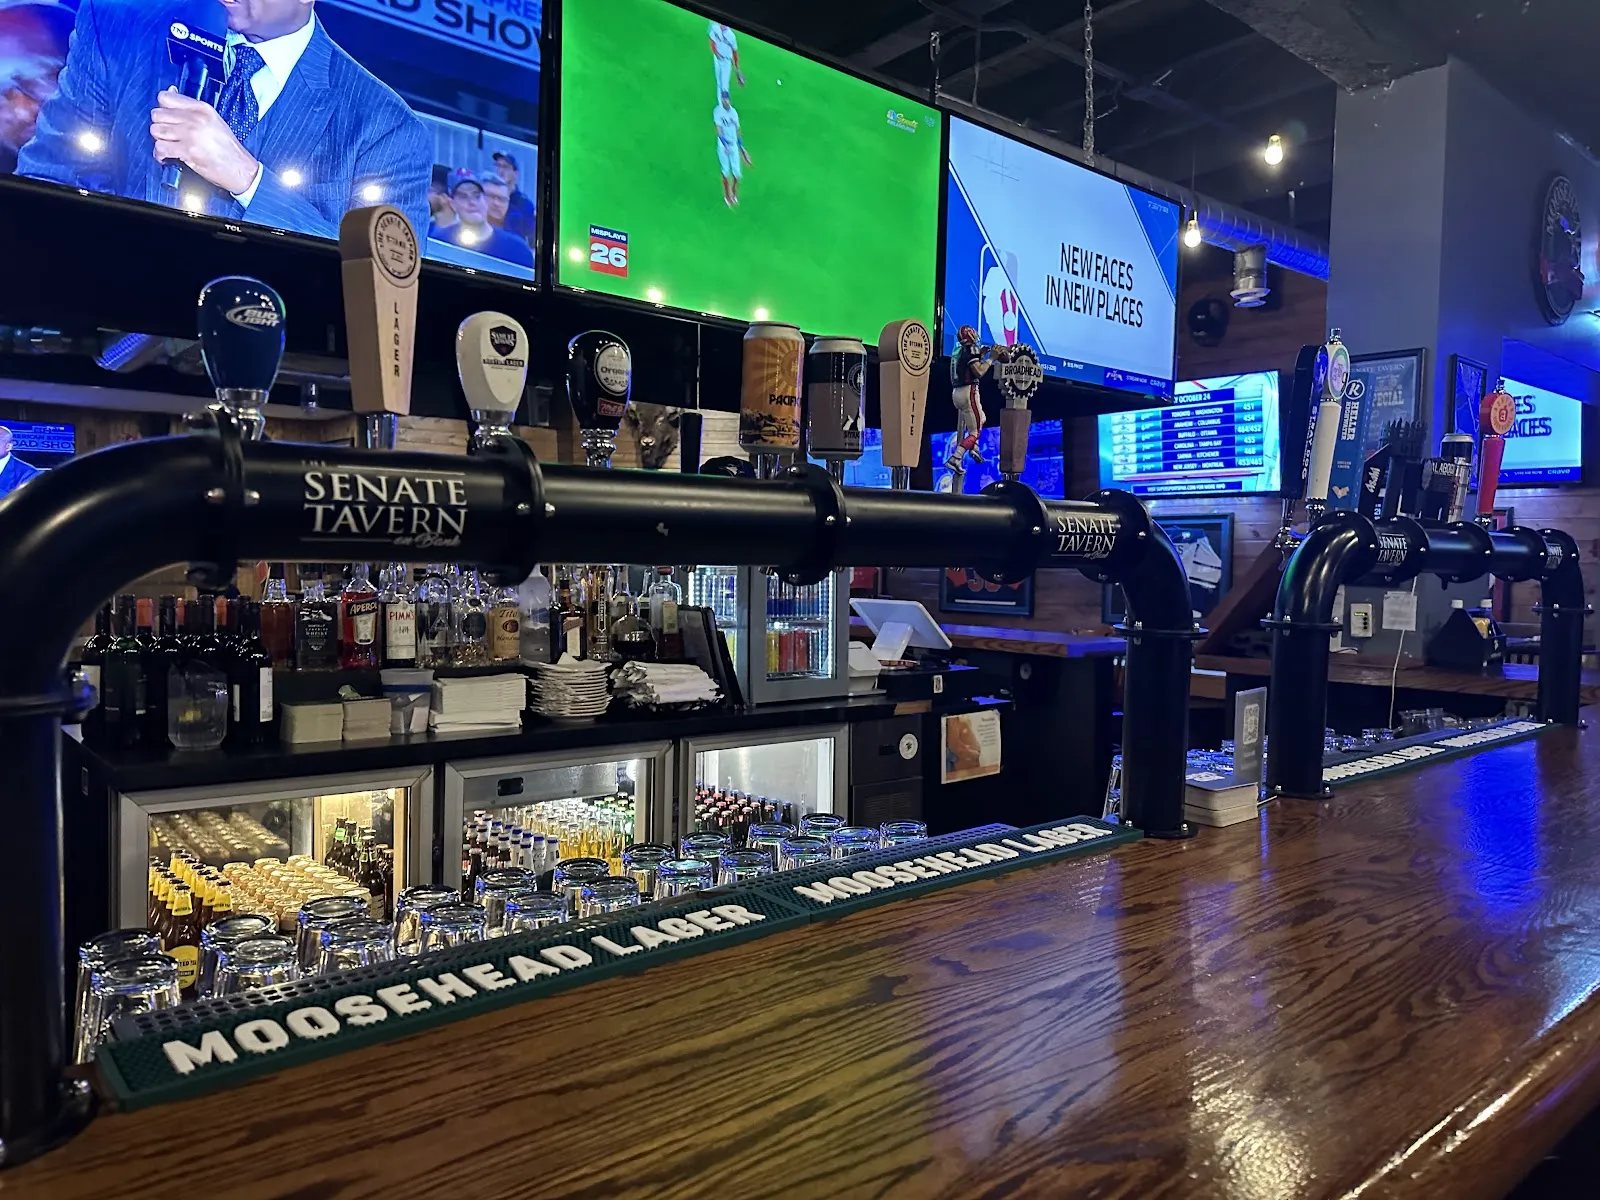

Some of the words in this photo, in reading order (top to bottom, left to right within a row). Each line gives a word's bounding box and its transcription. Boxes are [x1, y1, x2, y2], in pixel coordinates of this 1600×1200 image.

[189, 32, 224, 53] SPORTS
[224, 224, 242, 233] TCL
[591, 227, 627, 242] MISPLAYS
[590, 242, 627, 268] 26
[1060, 241, 1093, 280] NEW
[1094, 252, 1134, 292] FACES
[1045, 274, 1061, 308] IN
[1063, 278, 1095, 316] NEW
[1096, 288, 1144, 328] PLACES
[233, 314, 280, 327] LIGHT
[244, 308, 279, 321] BUD
[393, 301, 401, 378] LAGER
[490, 331, 515, 341] SAMUEL
[493, 338, 516, 347] ADAMS
[1004, 364, 1042, 379] BROADHEAD
[1348, 382, 1361, 396] K
[1179, 394, 1203, 404] OCTOBER
[1203, 393, 1211, 401] 24
[1171, 410, 1191, 418] TORONTO
[1195, 407, 1223, 416] WASHINGTON
[1243, 403, 1255, 411] 451
[1173, 421, 1194, 429] ANAHEIM
[1197, 418, 1222, 427] COLUMBUS
[1243, 414, 1255, 422] 454
[1347, 402, 1360, 440] HELLER
[1177, 431, 1196, 439] BUFFALO
[1200, 429, 1218, 437] OTTAWA
[1173, 442, 1195, 450] CAROLINA
[1196, 451, 1220, 459] KITCHENER
[1183, 462, 1197, 470] JERSEY
[1201, 461, 1225, 469] MONTREAL
[1364, 466, 1381, 493] Asahi
[304, 471, 468, 506] SENATE
[303, 503, 469, 536] TAVERN
[1057, 514, 1117, 535] SENATE
[412, 532, 461, 549] Bank
[1057, 534, 1117, 552] TAVERN
[1379, 536, 1407, 550] SENATE
[1377, 549, 1408, 562] TAVERN
[389, 610, 415, 621] PIMM'S
[793, 838, 1020, 905] MOOSEHEAD
[1021, 823, 1113, 853] LAGER
[162, 942, 594, 1076] MOOSEHEAD
[591, 903, 767, 957] LAGER
